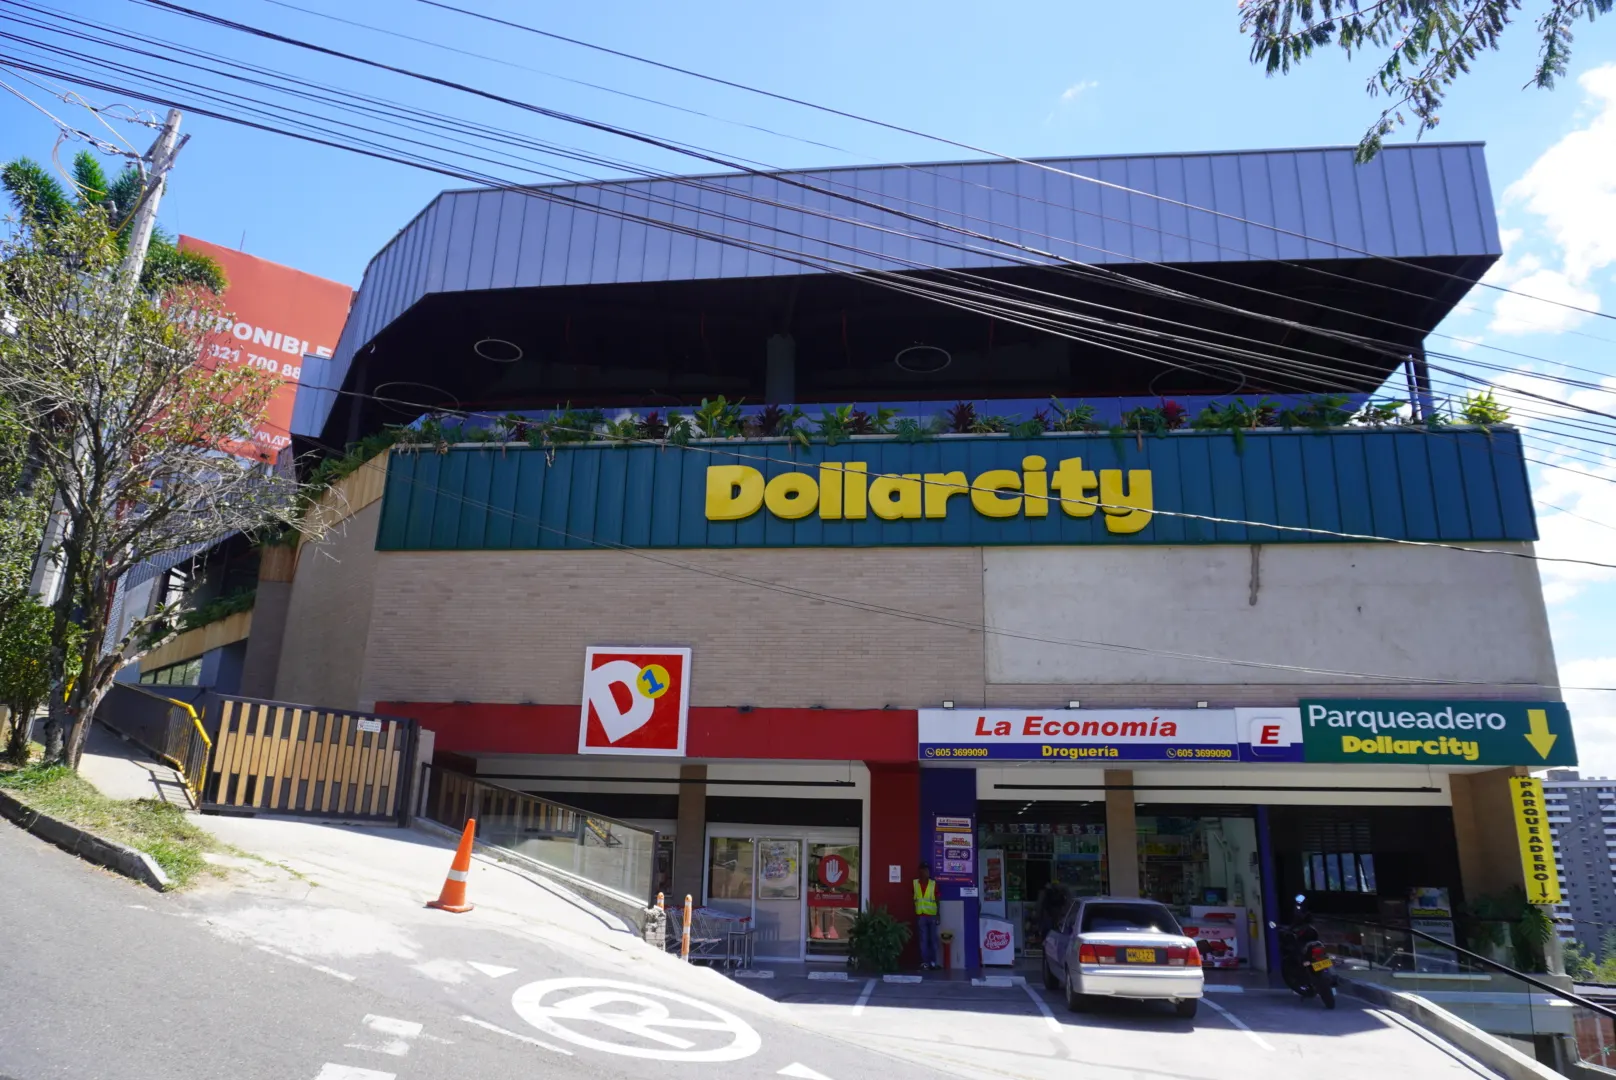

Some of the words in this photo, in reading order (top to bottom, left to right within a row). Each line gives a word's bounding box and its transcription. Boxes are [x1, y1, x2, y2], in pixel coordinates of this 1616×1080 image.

[247, 353, 278, 374] 700
[705, 455, 1152, 534] Dollarcity
[586, 660, 665, 744] D1
[974, 716, 1011, 737] La
[1021, 716, 1178, 738] Economía
[1308, 704, 1506, 734] Parqueadero
[1259, 725, 1281, 744] E
[935, 748, 951, 758] 605
[952, 748, 988, 758] 3699090
[1041, 745, 1119, 758] Droguería
[1177, 748, 1193, 758] 605
[1195, 749, 1232, 759] 3699090
[1341, 735, 1480, 761] Dollarcity
[1519, 781, 1550, 881] PARQUEADERO
